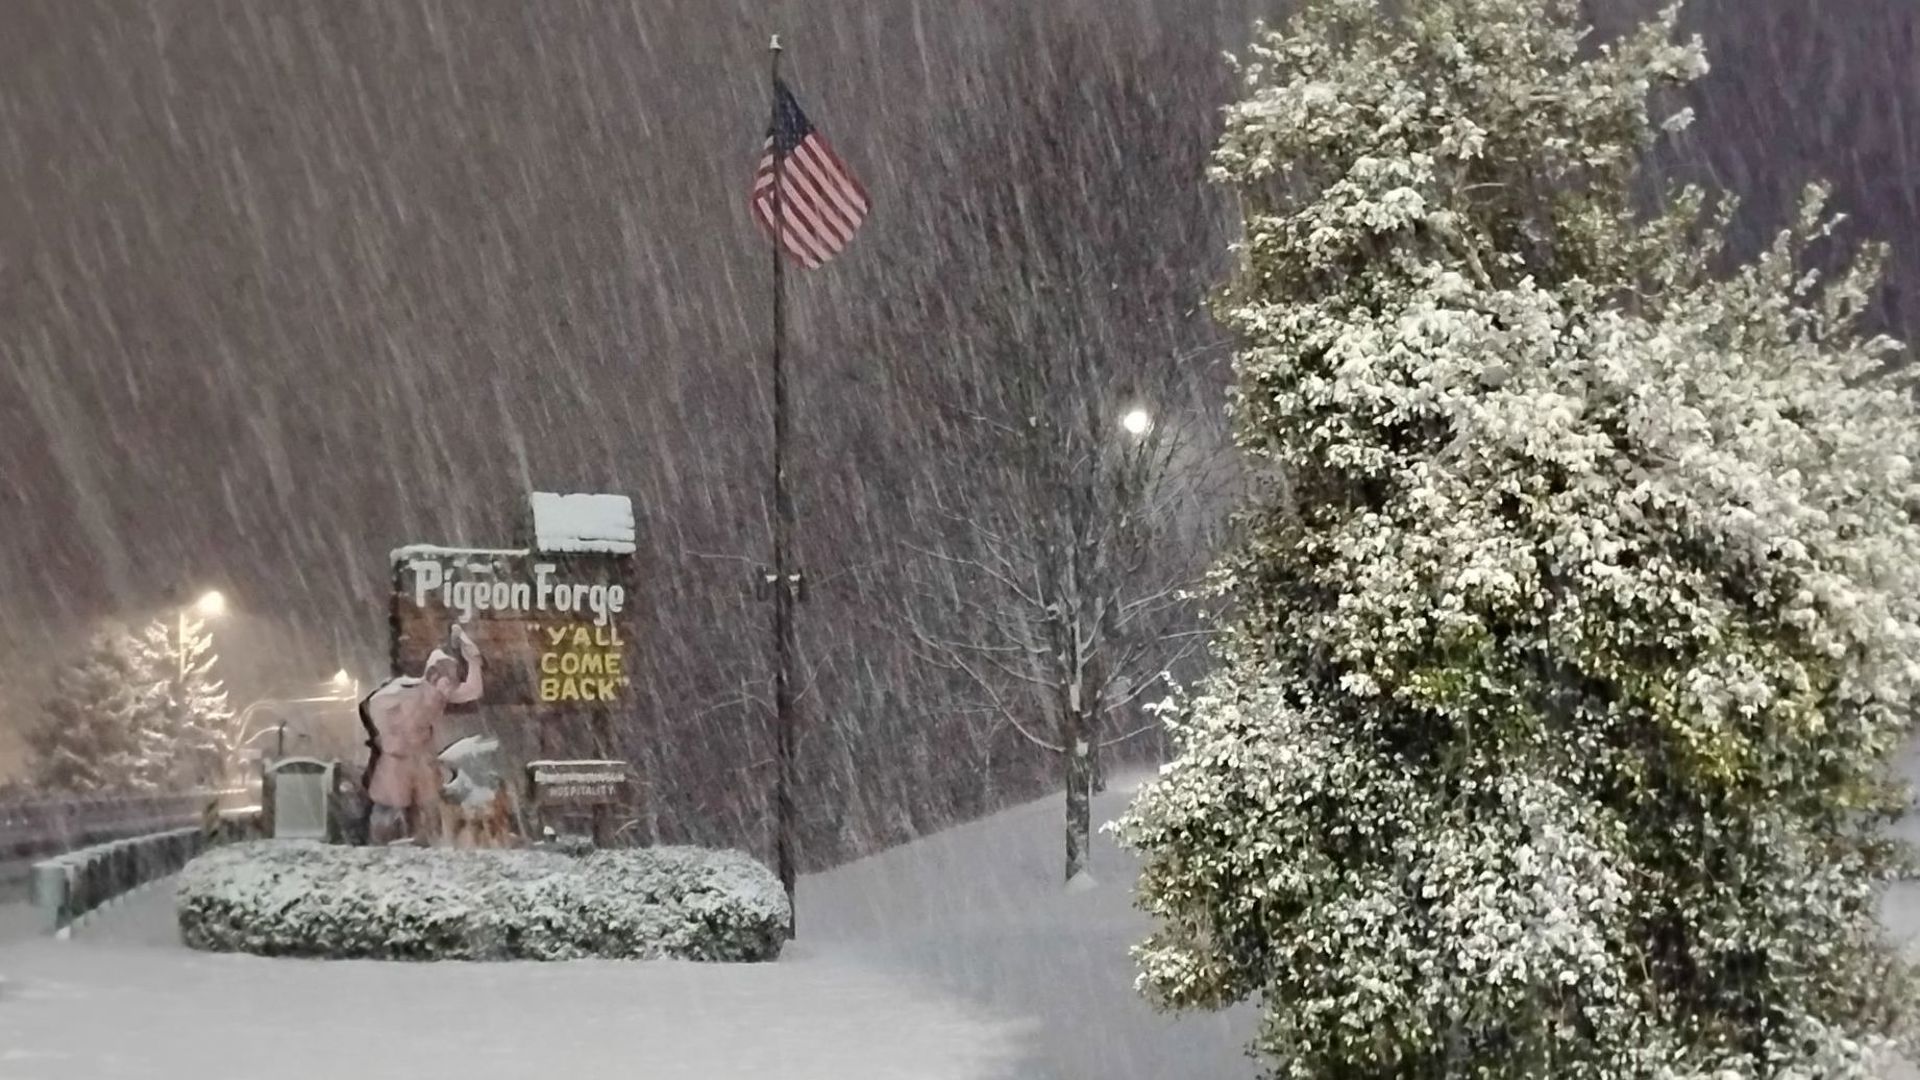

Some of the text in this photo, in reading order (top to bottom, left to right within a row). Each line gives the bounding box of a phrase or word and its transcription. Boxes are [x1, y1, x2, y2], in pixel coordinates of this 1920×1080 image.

[411, 561, 625, 626] Pigeon Forge
[541, 652, 622, 675] COME
